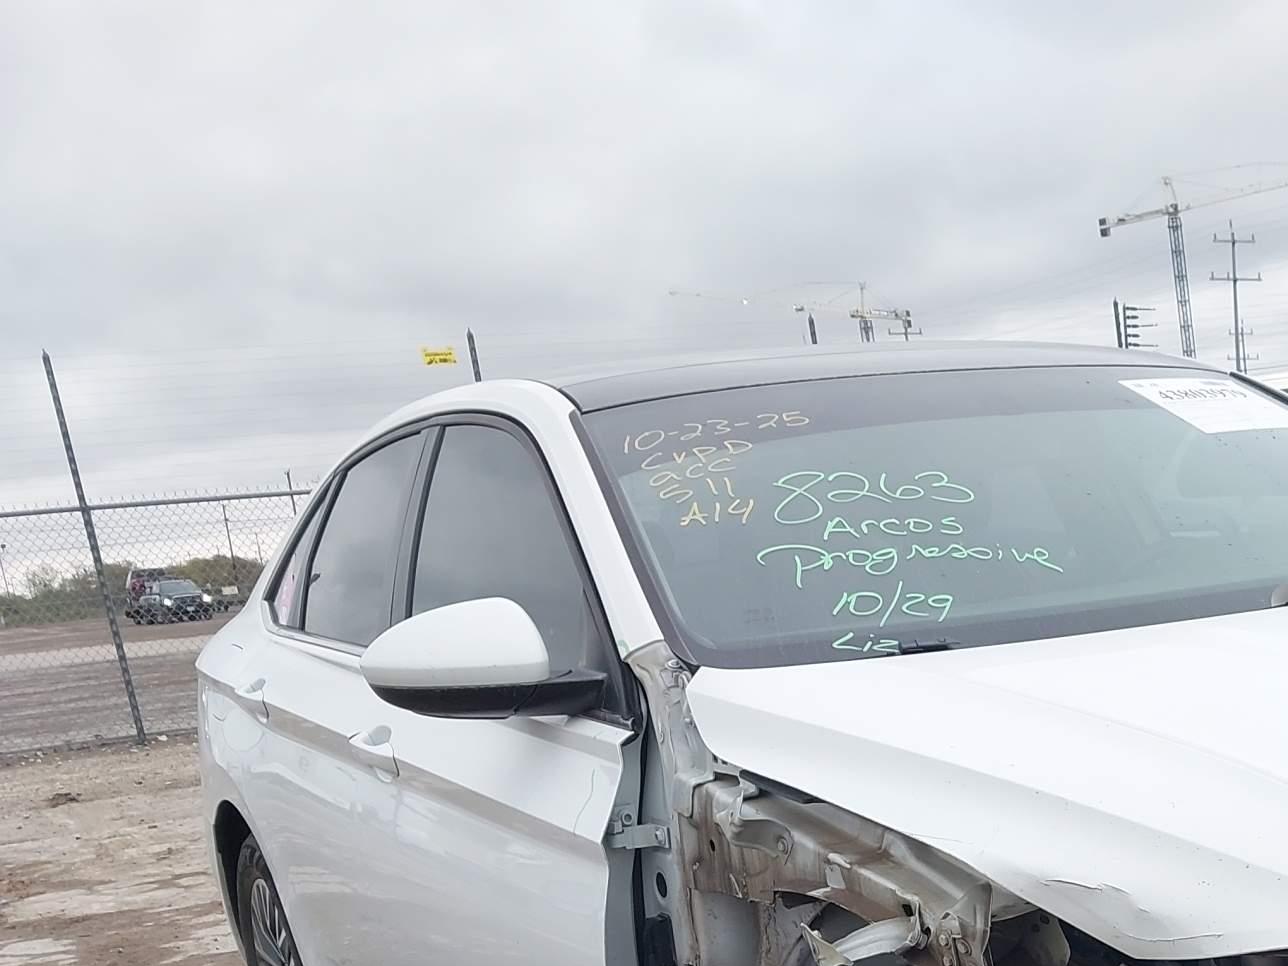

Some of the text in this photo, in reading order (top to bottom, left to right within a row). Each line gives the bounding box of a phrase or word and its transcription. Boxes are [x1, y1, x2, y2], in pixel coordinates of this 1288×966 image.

[624, 411, 810, 454] 10-23-25
[679, 499, 754, 526] A14
[773, 471, 975, 524] 8263
[832, 581, 953, 627] 10/29
